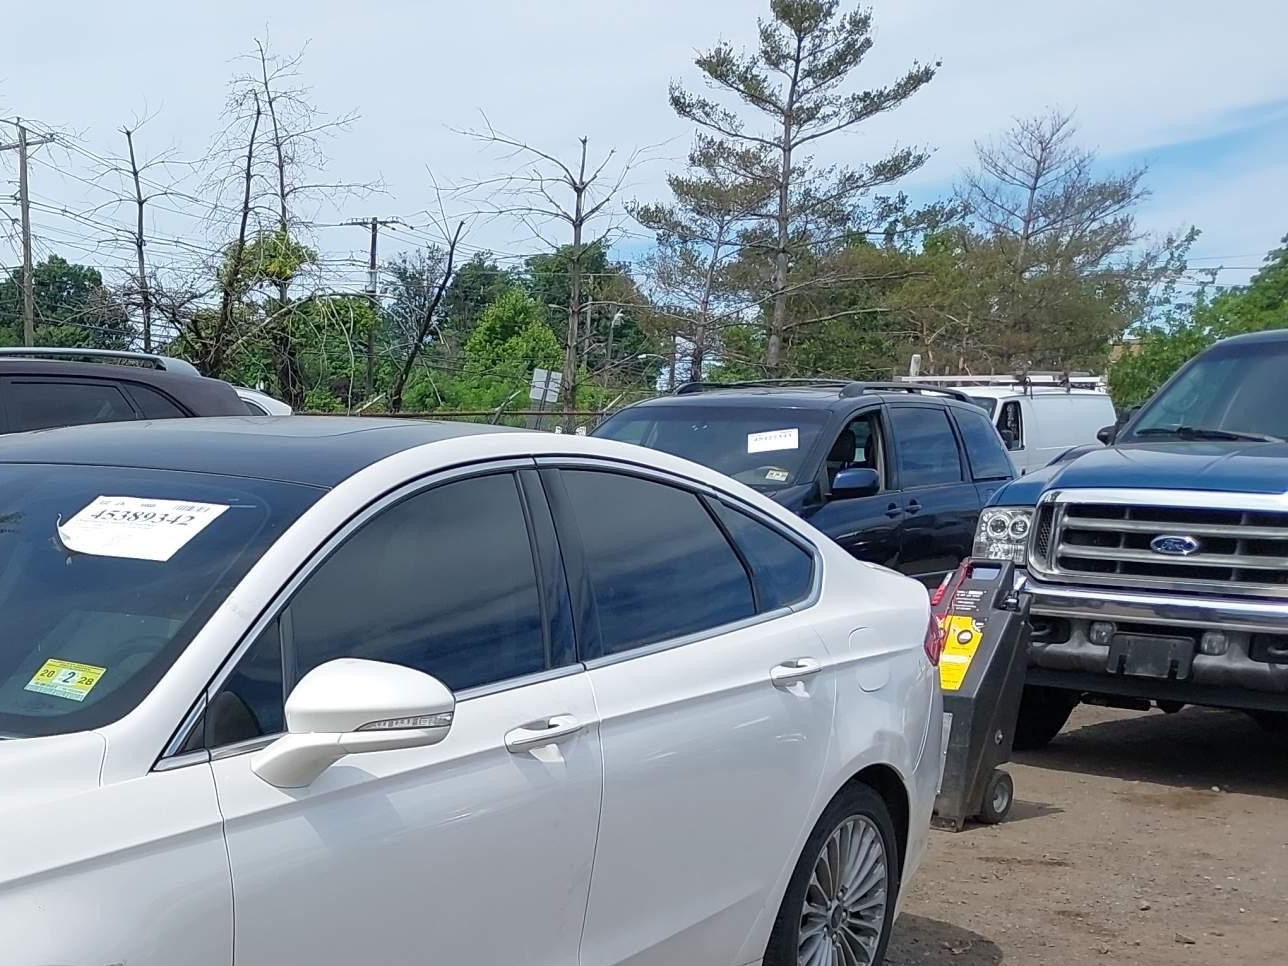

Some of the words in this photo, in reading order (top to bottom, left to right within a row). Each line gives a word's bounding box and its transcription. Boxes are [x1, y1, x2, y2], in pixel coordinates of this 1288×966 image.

[90, 508, 196, 527] 45389342
[40, 669, 56, 678] 20
[62, 671, 76, 684] 2
[78, 676, 94, 686] 28
